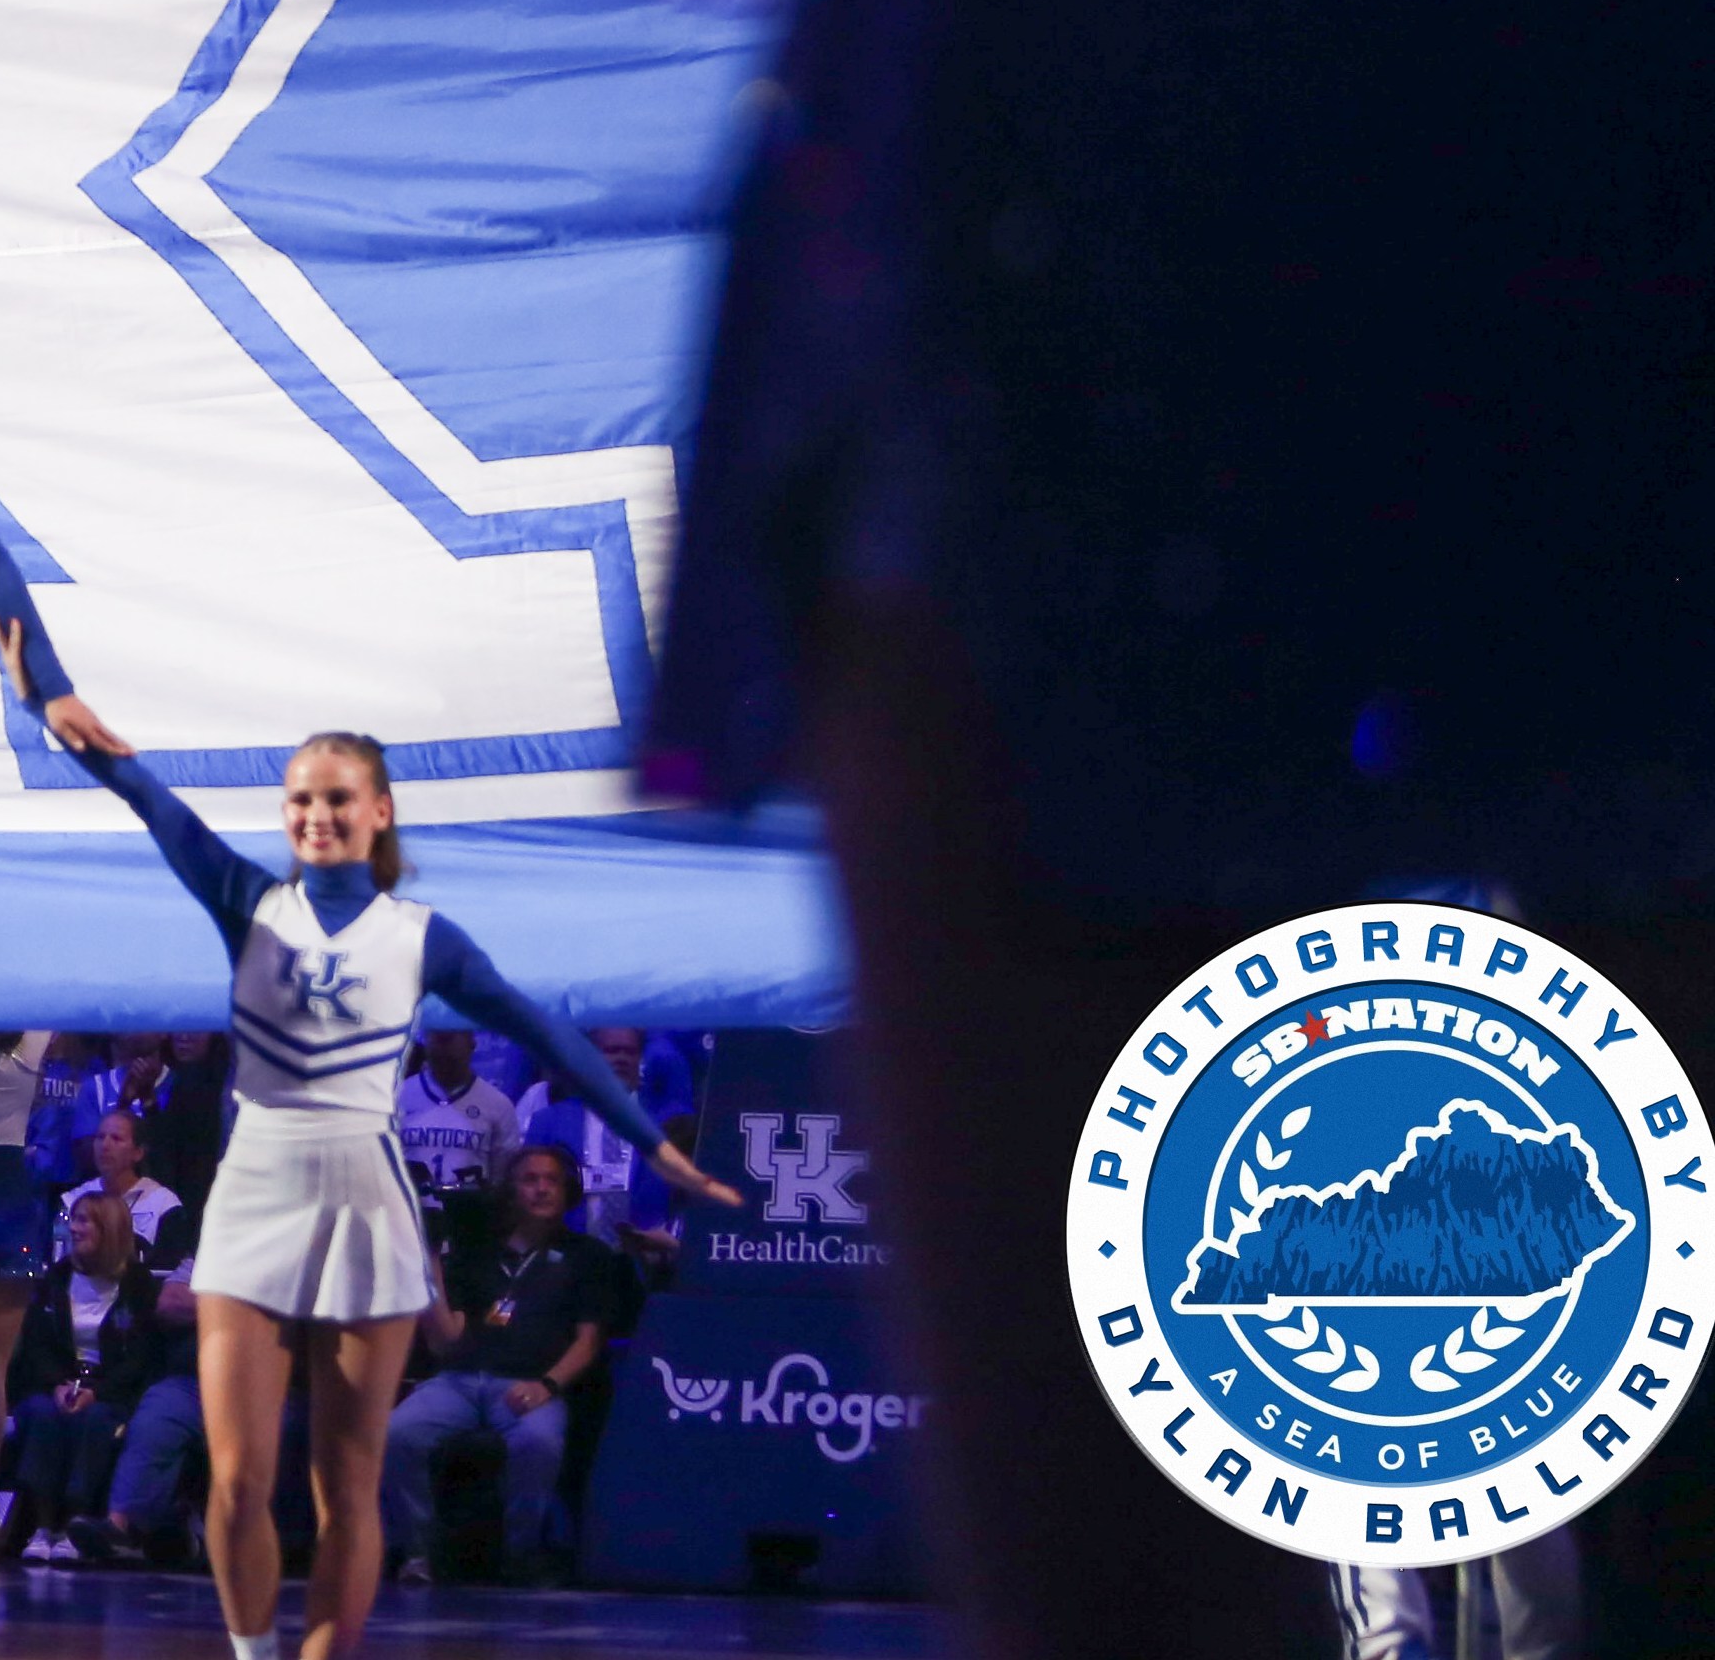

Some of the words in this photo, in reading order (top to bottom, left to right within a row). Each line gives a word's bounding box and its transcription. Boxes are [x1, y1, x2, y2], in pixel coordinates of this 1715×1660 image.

[276, 943, 368, 1026] UK
[400, 1127, 485, 1153] KENTUCKY
[739, 1112, 870, 1224] UK
[708, 1231, 895, 1264] HealthCare
[740, 1353, 928, 1462] Kroger
